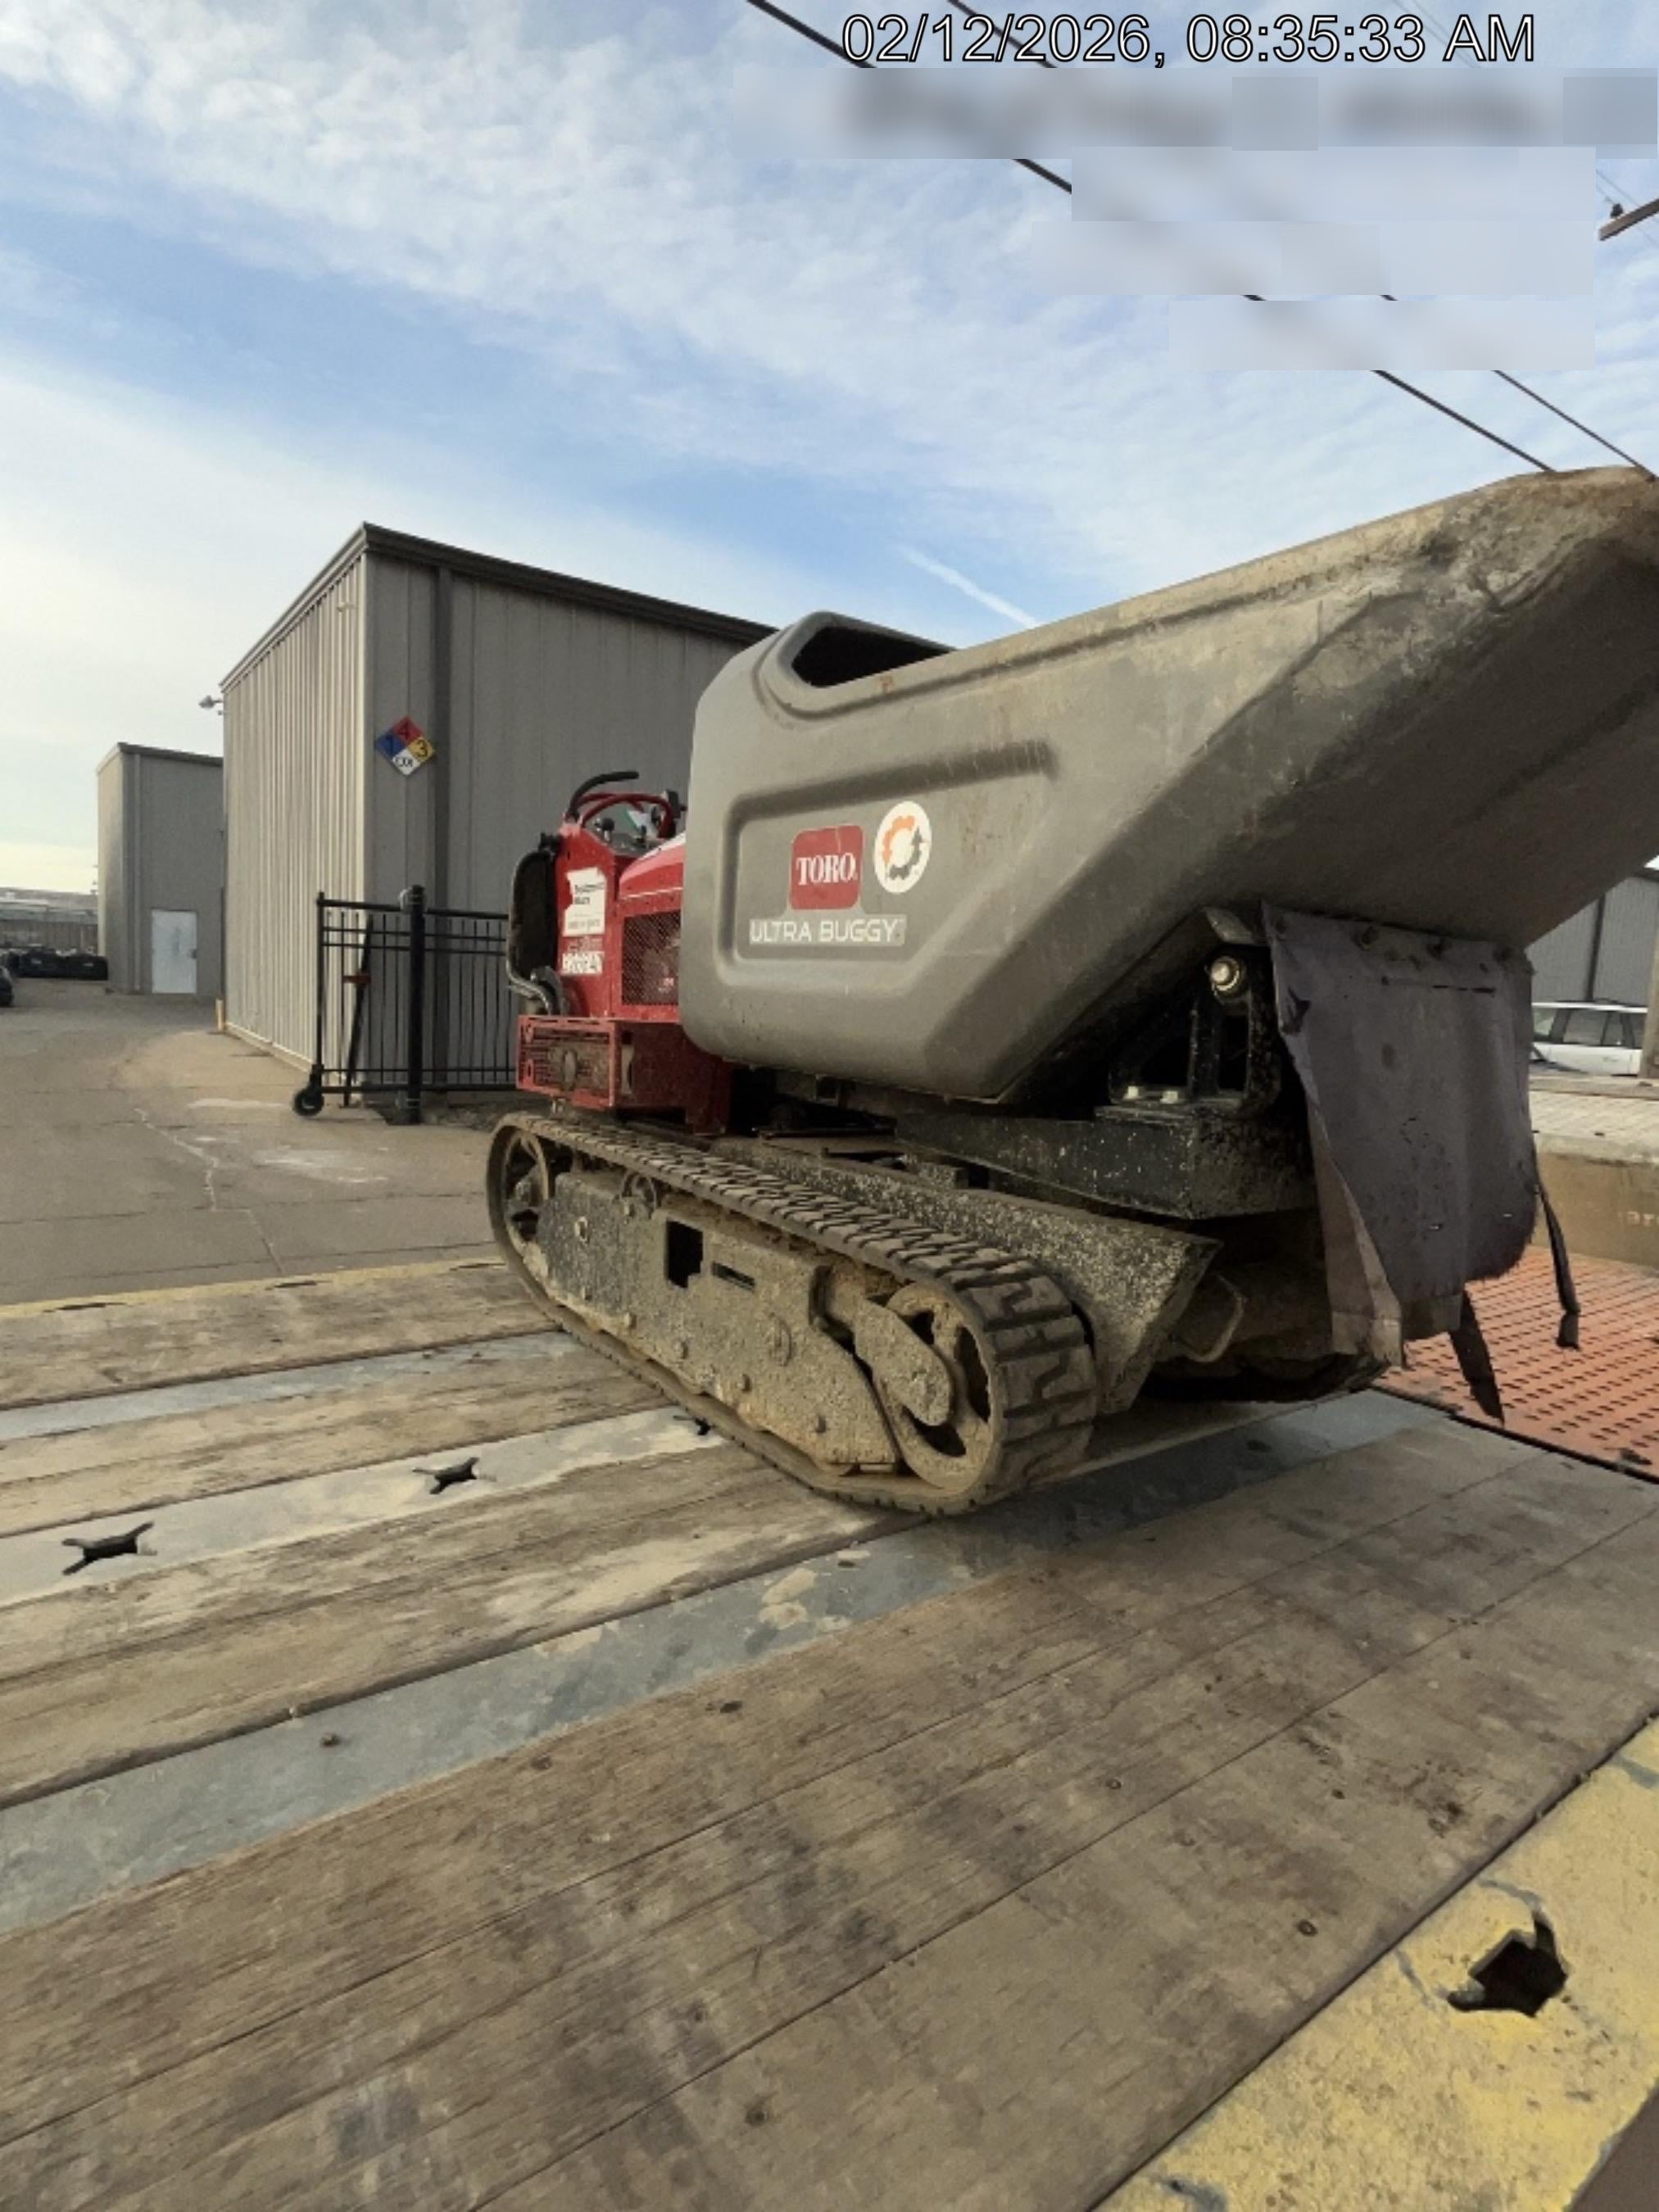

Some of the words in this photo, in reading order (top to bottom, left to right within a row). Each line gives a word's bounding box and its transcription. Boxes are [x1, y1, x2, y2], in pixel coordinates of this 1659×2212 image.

[416, 739, 428, 757] 3
[796, 852, 856, 886] TORO
[750, 919, 812, 942] ULTRA
[818, 918, 898, 942] BUGGY
